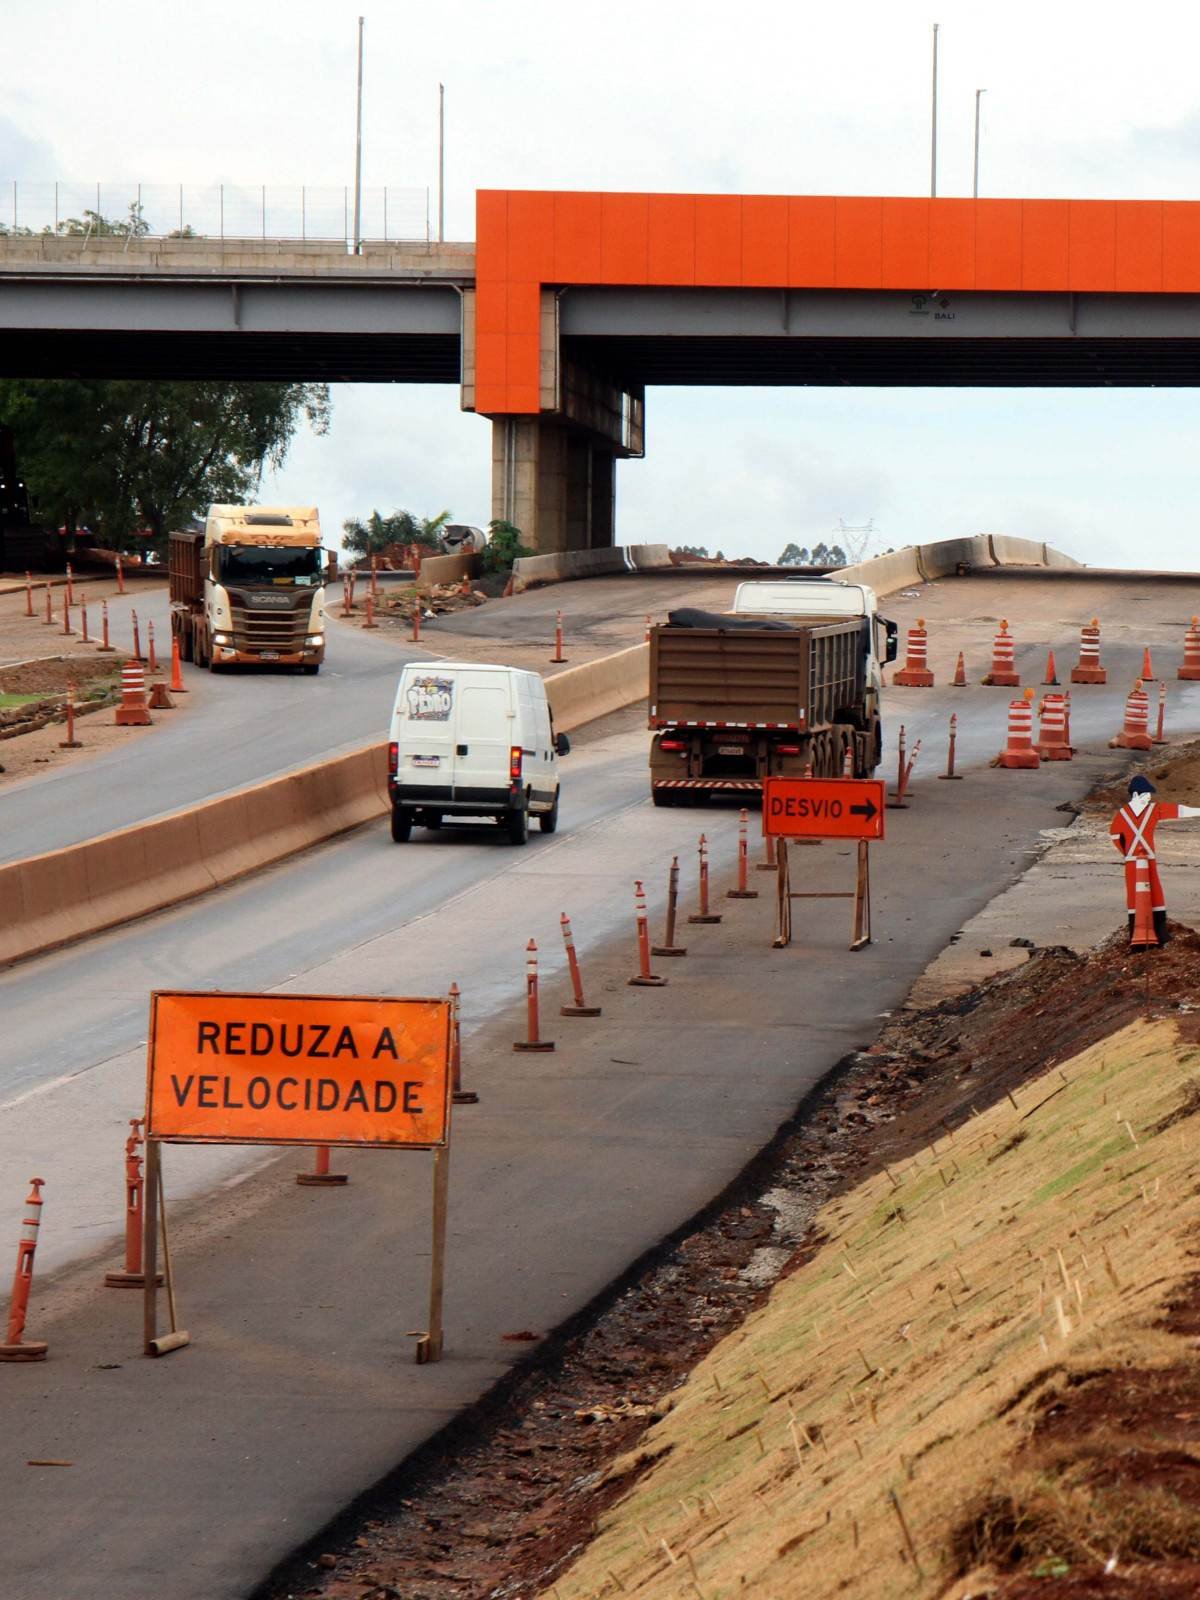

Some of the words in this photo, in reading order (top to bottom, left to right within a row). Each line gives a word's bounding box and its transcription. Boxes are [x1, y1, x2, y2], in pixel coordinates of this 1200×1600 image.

[251, 595, 290, 604] SCANIA
[770, 797, 843, 819] DESVIO
[196, 1021, 359, 1060] REDUZA
[371, 1026, 399, 1060] A
[170, 1074, 424, 1114] VELOCIDADE
